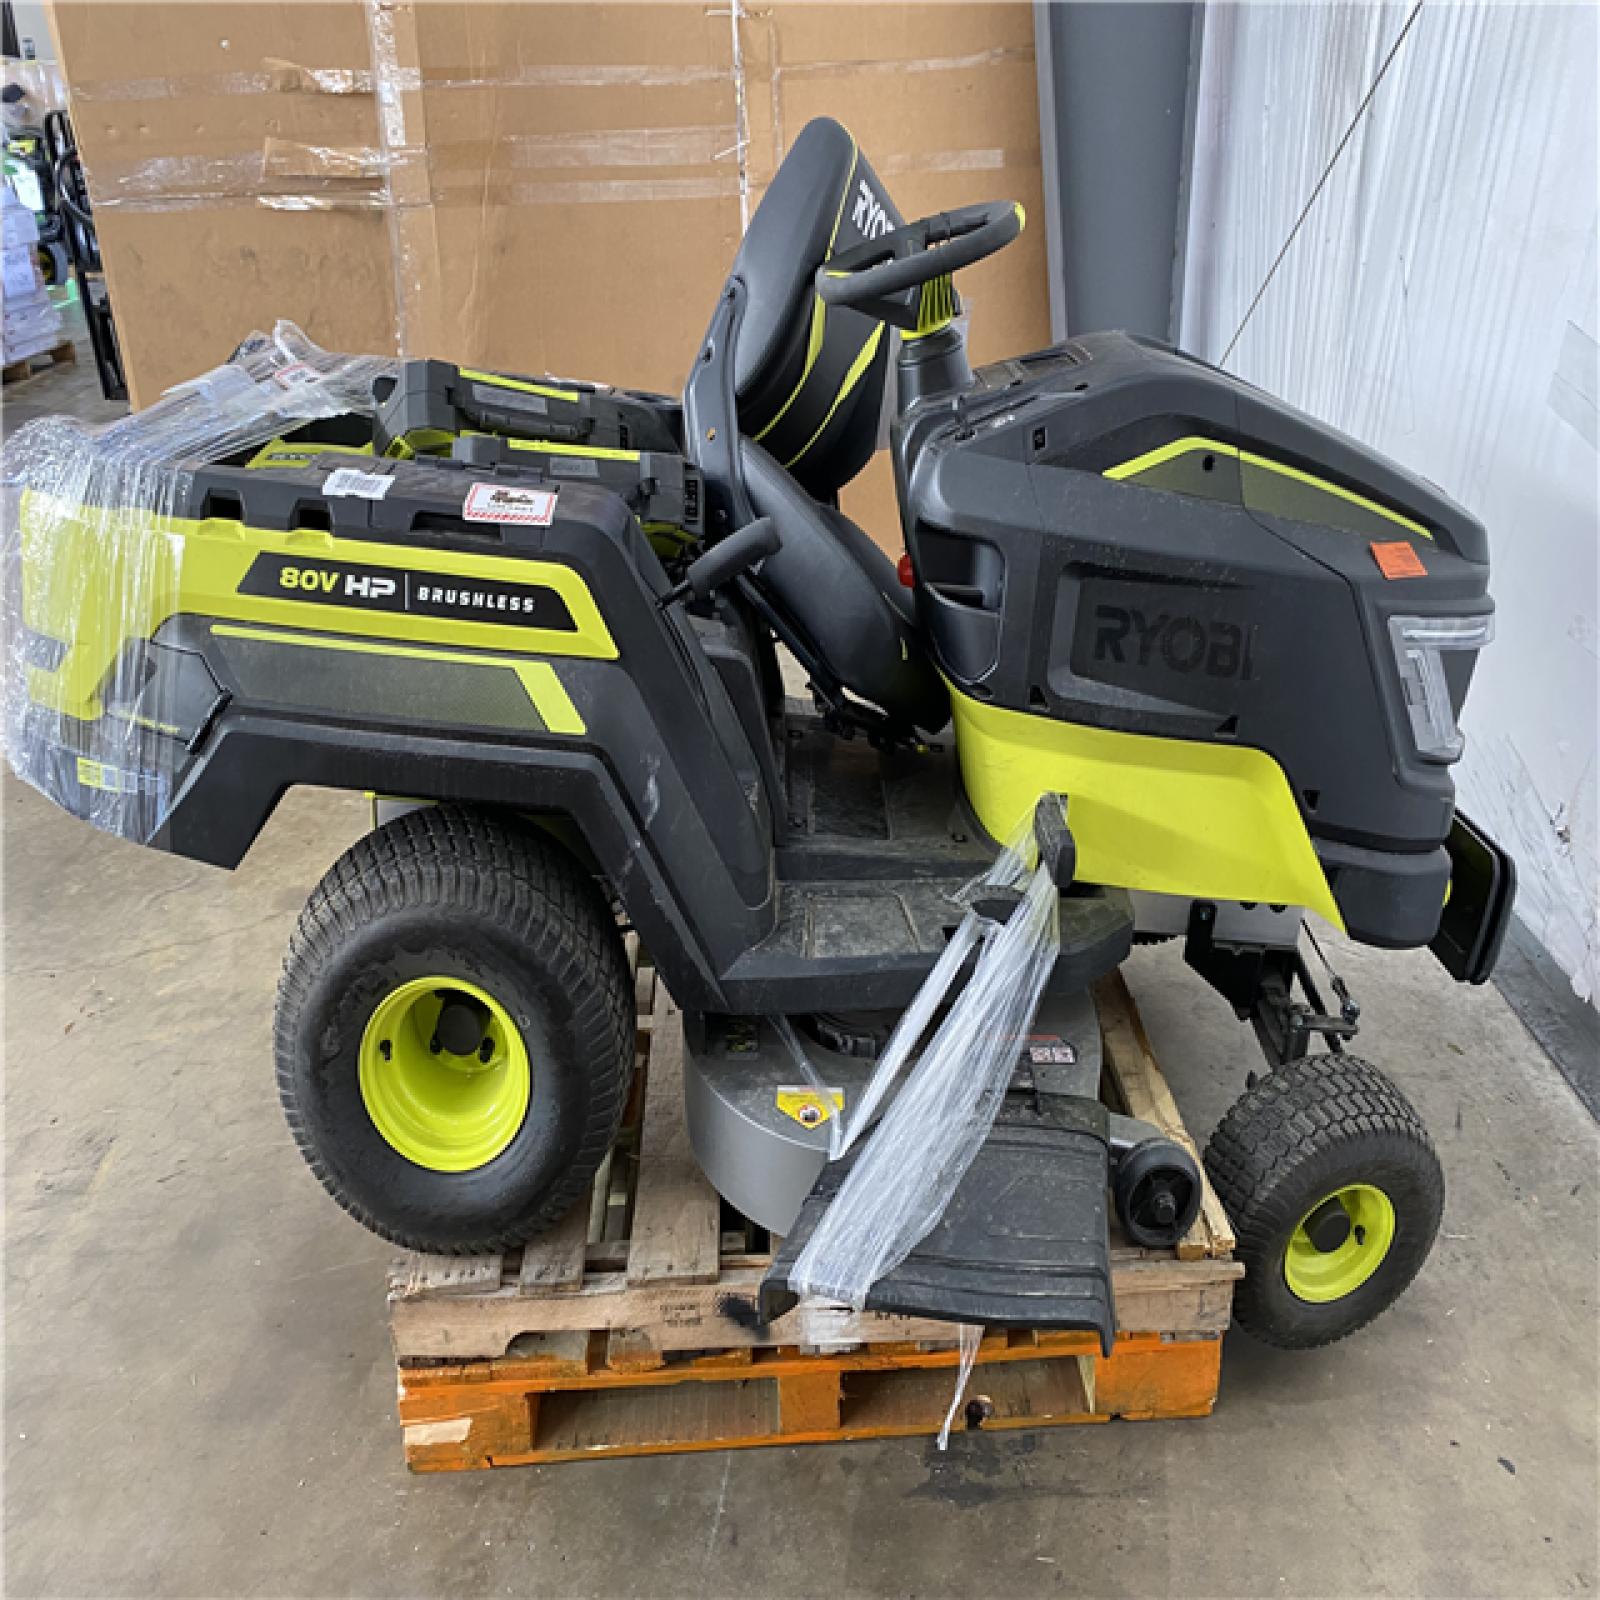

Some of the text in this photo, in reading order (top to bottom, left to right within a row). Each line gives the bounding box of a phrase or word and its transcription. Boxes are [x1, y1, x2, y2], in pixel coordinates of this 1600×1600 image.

[852, 180, 896, 240] RYO
[279, 566, 536, 613] 80V HP BRUSHLESS
[1093, 604, 1254, 681] RYOBI
